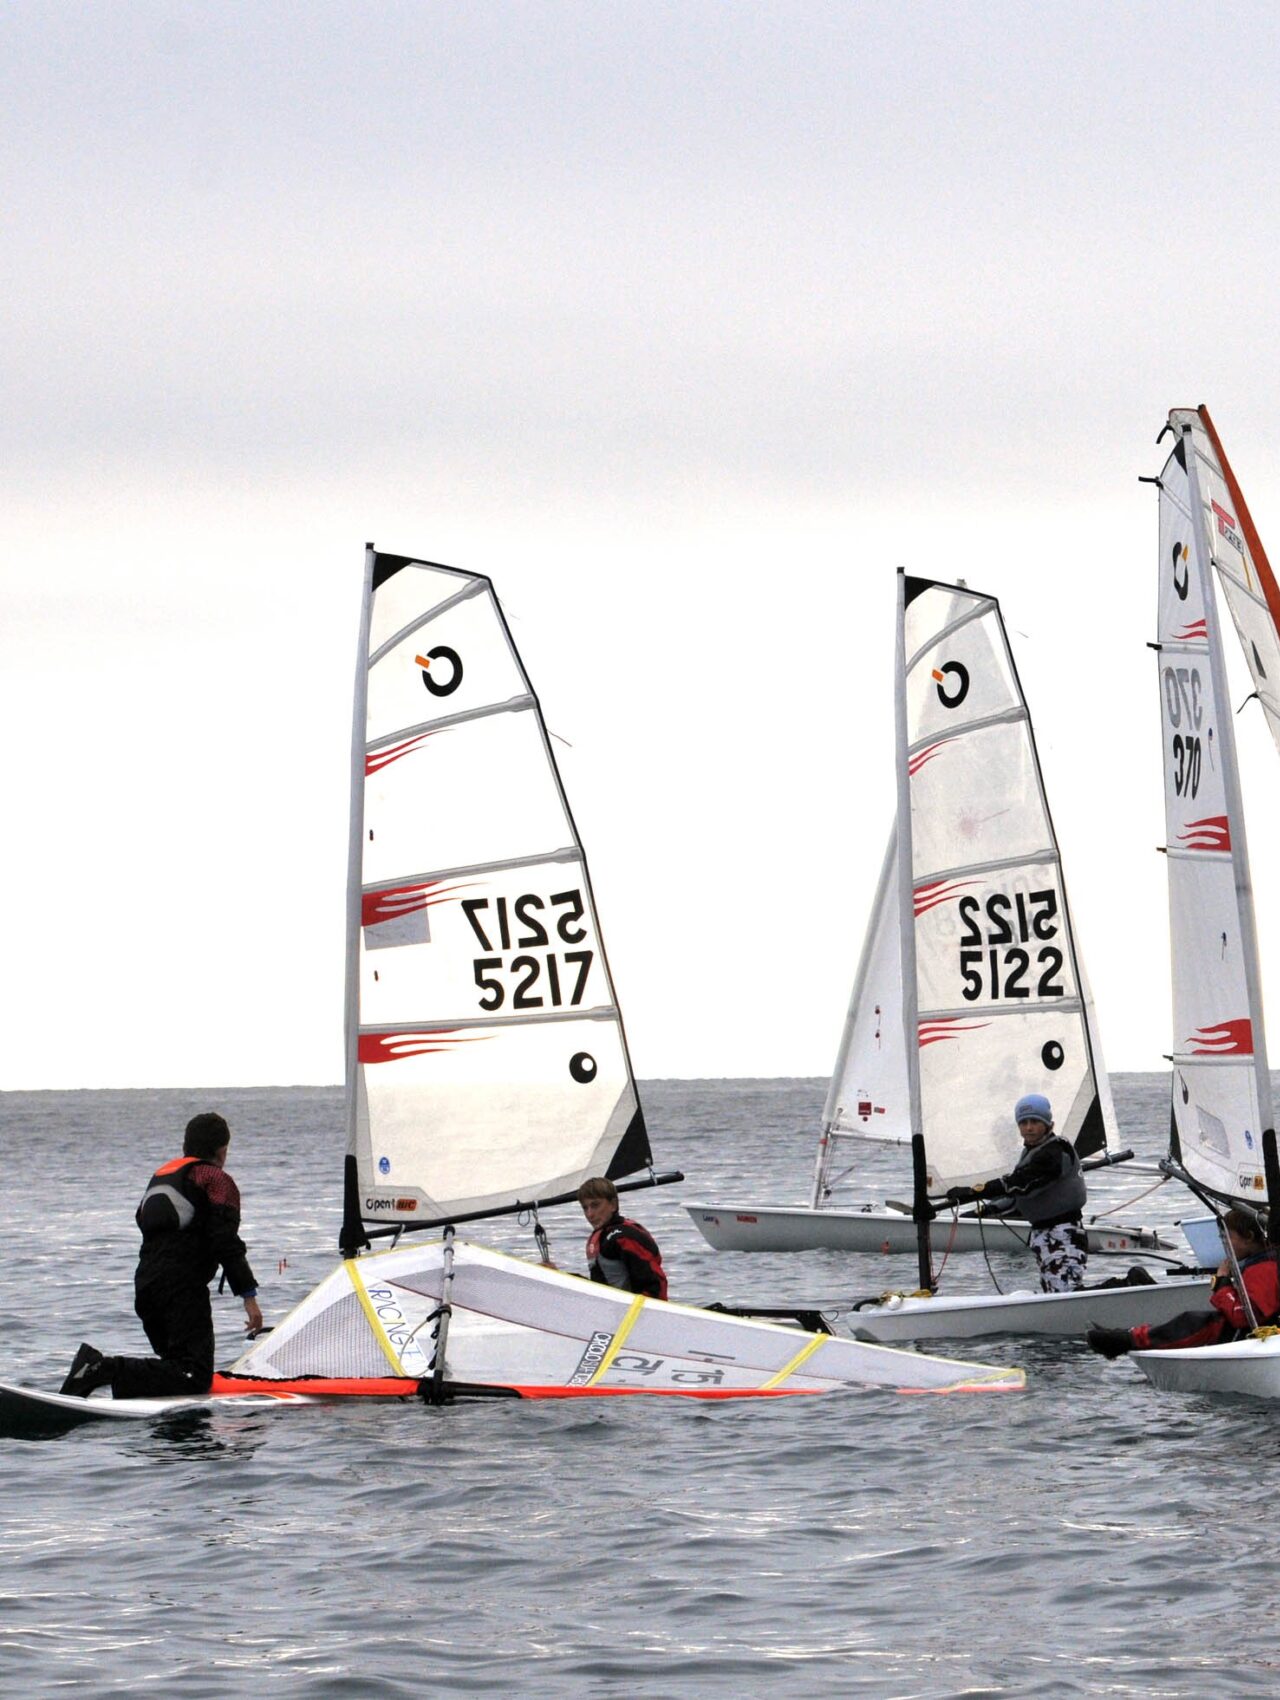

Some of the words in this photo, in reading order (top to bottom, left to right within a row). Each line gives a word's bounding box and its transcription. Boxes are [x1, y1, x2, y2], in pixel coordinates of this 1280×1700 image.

[1173, 734, 1201, 800] 370
[473, 951, 594, 1011] 5217
[960, 947, 1064, 1000] 5122
